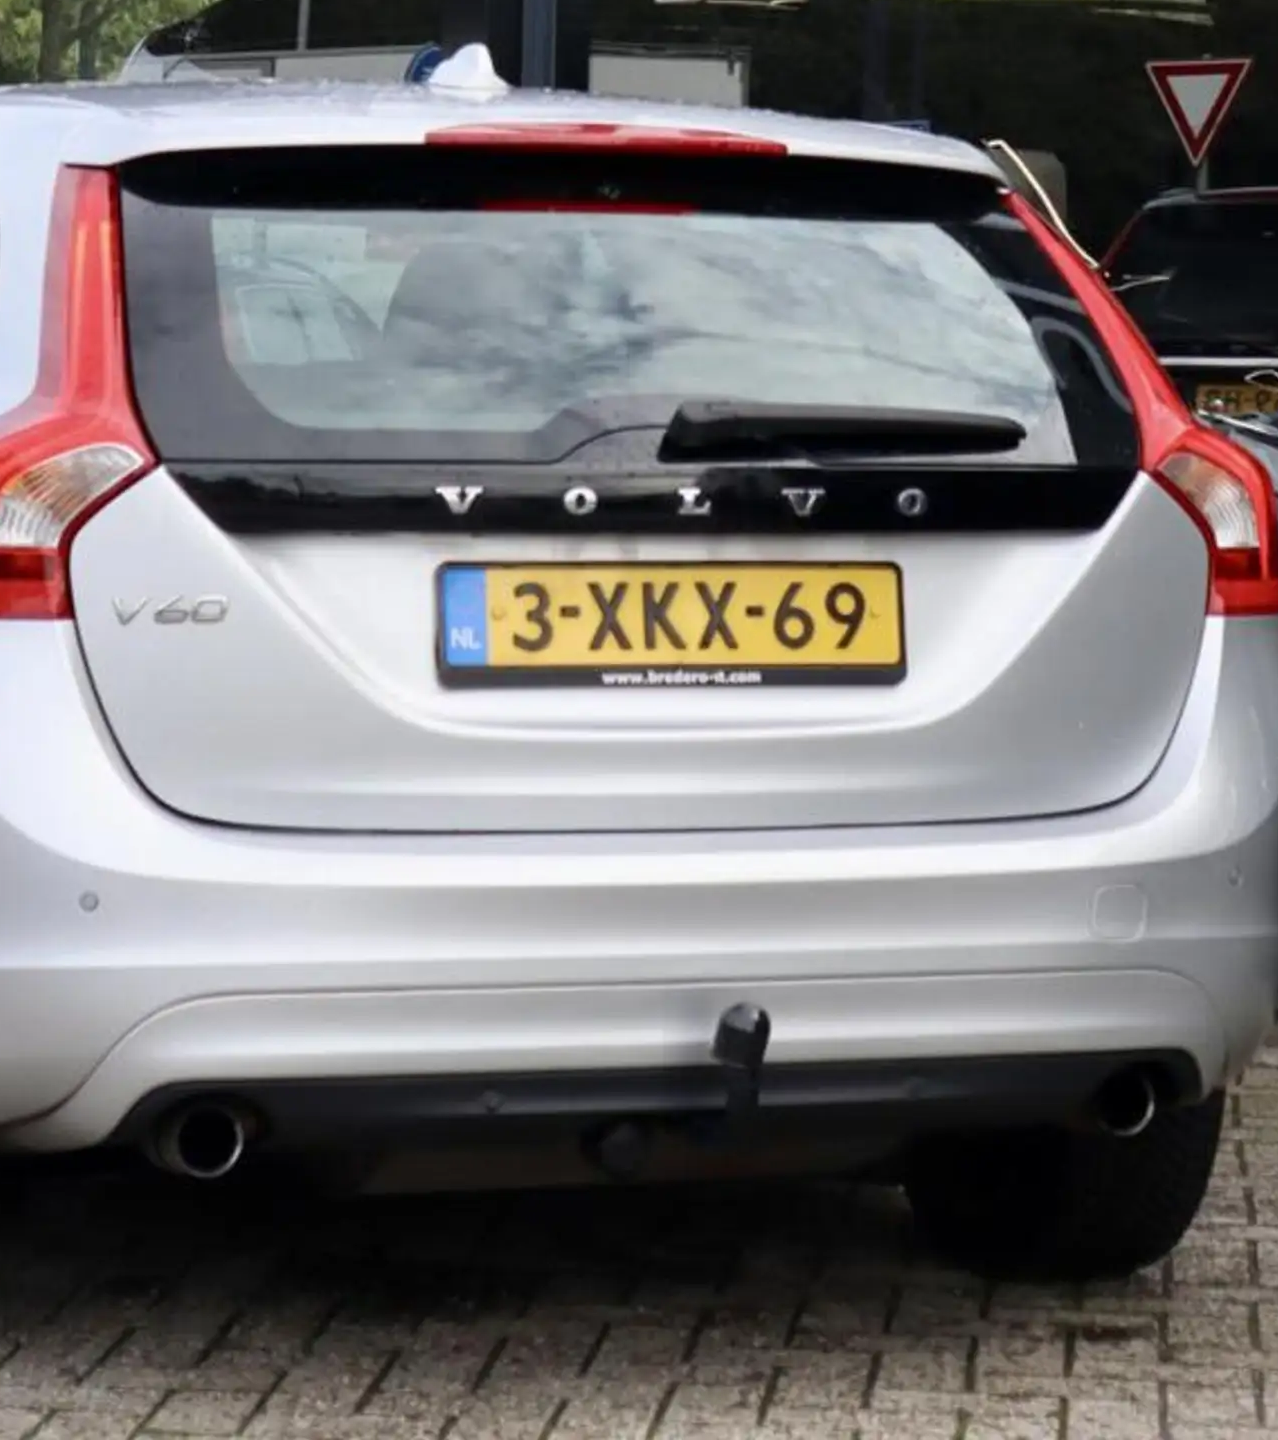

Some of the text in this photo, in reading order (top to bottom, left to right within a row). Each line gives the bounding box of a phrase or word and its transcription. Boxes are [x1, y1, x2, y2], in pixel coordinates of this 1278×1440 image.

[435, 485, 927, 516] VOLVO
[111, 593, 230, 626] V60
[512, 581, 866, 652] 3-XKX-69
[451, 628, 481, 649] NL
